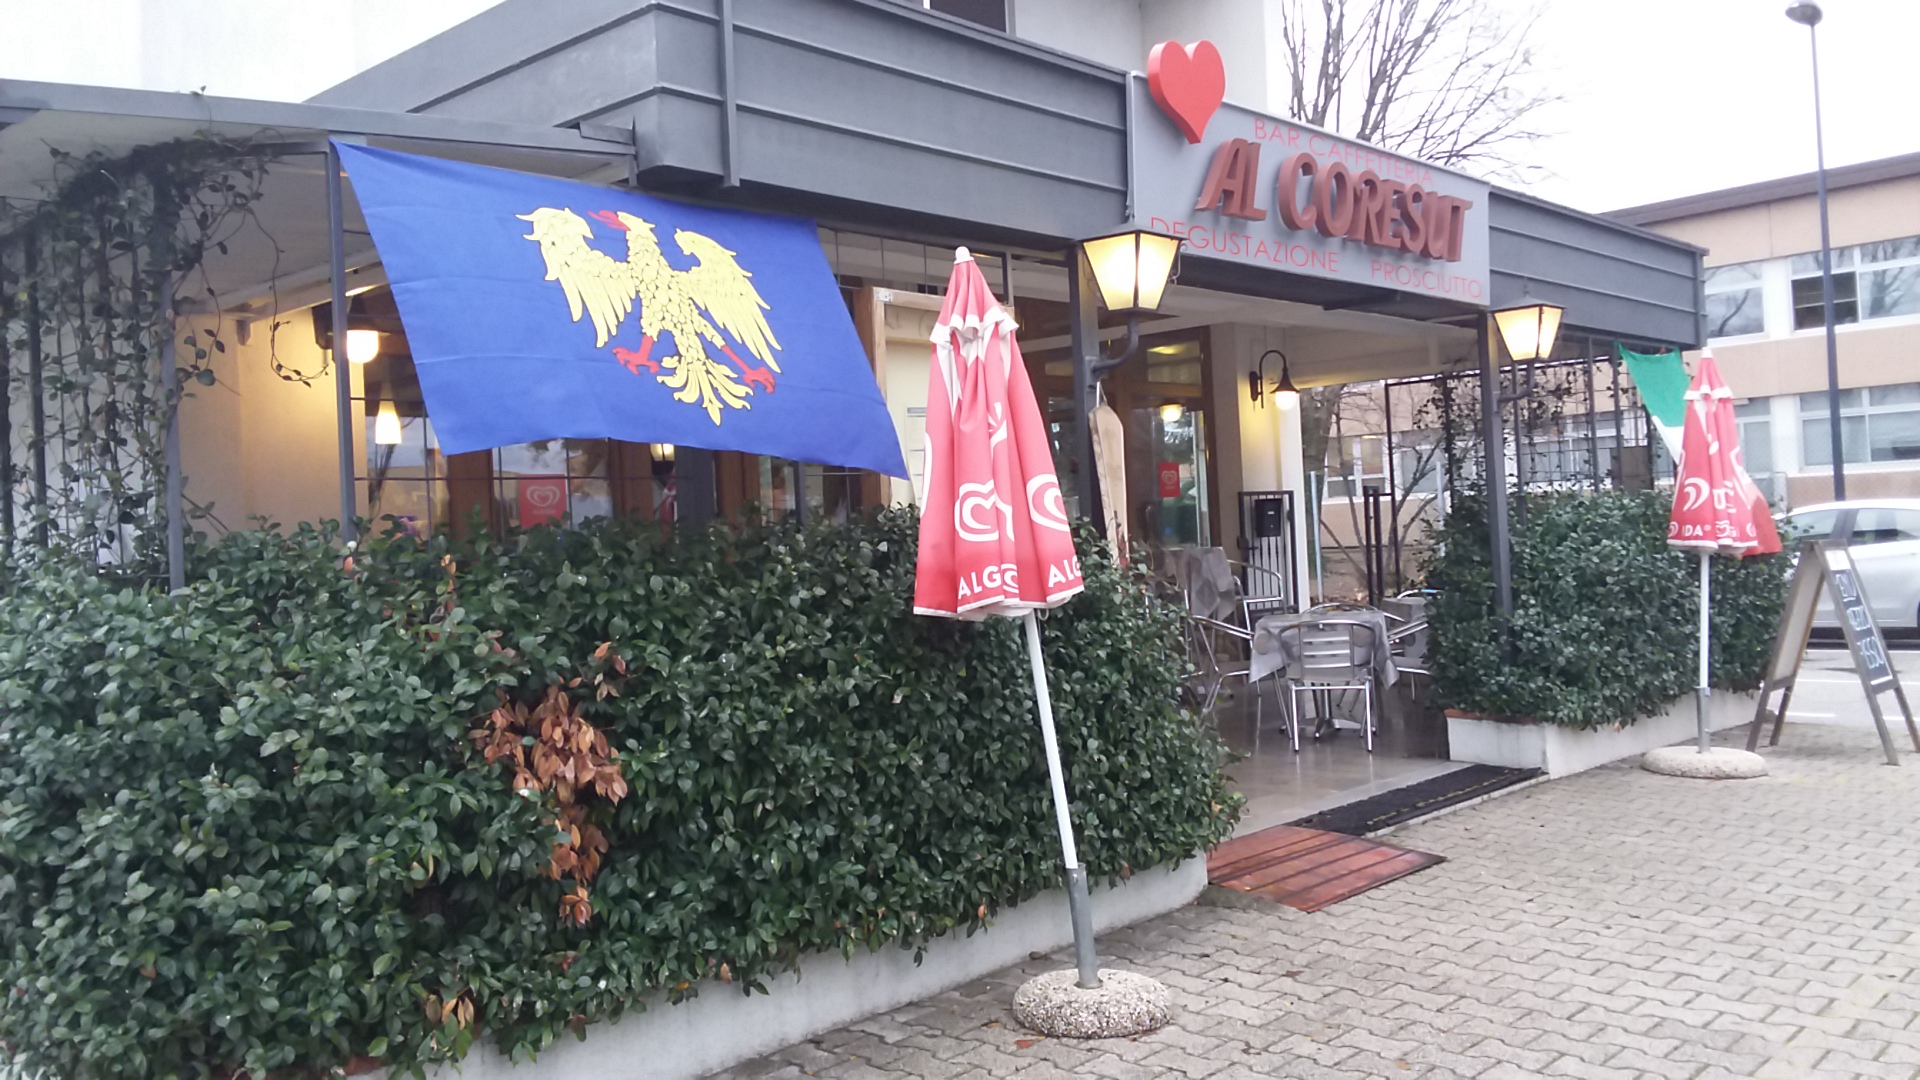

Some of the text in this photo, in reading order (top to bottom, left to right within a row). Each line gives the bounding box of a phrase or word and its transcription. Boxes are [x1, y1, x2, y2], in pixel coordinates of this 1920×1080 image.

[1254, 117, 1434, 188] BAR CAFFETTERIA
[1194, 137, 1473, 262] AL CORESUT
[1151, 216, 1339, 273] DEGUSTAZIONE
[1371, 259, 1483, 299] PROSCIUTTO
